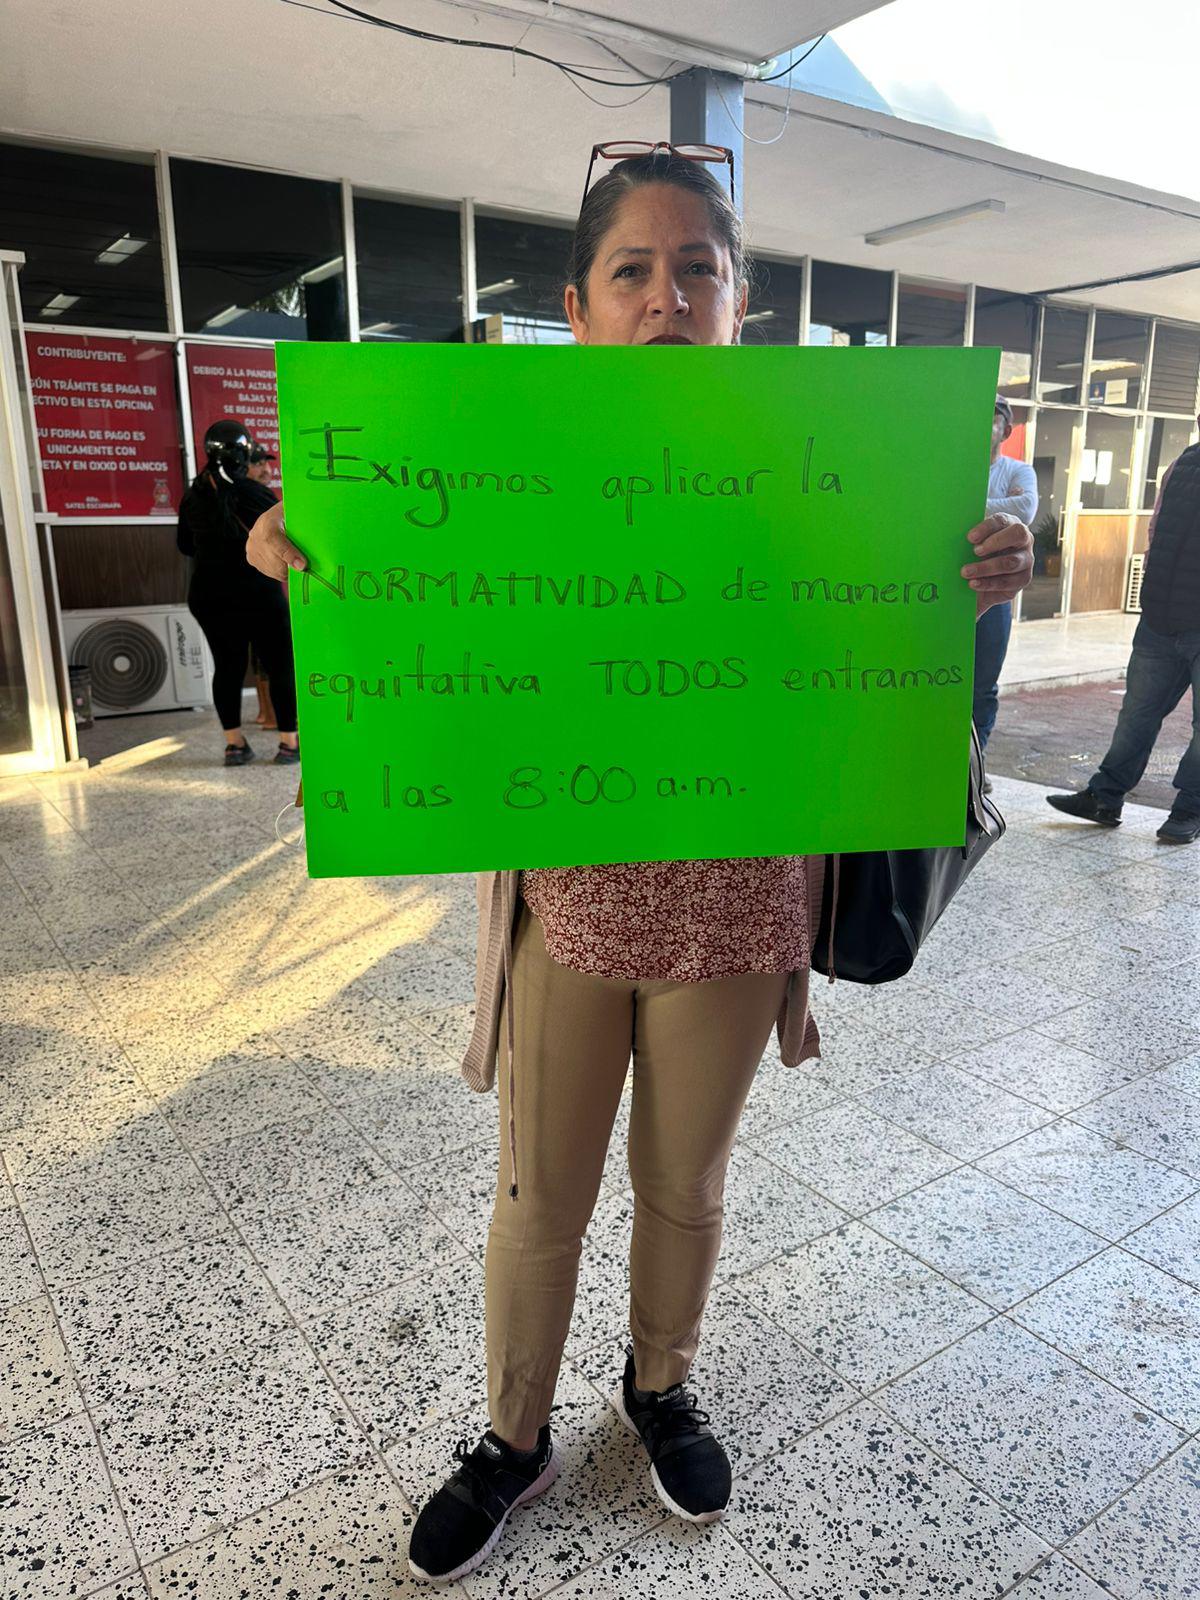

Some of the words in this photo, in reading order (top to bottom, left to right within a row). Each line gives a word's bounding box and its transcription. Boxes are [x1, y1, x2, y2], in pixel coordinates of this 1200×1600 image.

[37, 346, 127, 362] CONTRIBUYENTE:
[193, 366, 225, 376] DEBIDO
[226, 368, 233, 377] A
[234, 368, 246, 377] LA
[52, 379, 99, 392] TRÁMITE
[100, 383, 114, 393] SE
[115, 384, 141, 395] PAGA
[143, 386, 157, 396] EN
[222, 380, 246, 389] PARA
[70, 397, 85, 408] EN
[87, 398, 113, 409] ESTA
[114, 400, 154, 411] OFICINA
[238, 394, 265, 403] BAJAS
[224, 405, 235, 414] SE
[236, 406, 276, 415] REALIZAN
[244, 418, 256, 426] DE
[50, 428, 87, 439] FORMA
[88, 430, 103, 440] DE
[104, 430, 130, 441] PAGO
[132, 431, 145, 441] ES
[47, 444, 114, 456] UNICAMENTE
[115, 446, 136, 456] CON
[63, 461, 72, 470] Y
[73, 461, 87, 471] EN
[89, 462, 117, 471] OXXO
[118, 462, 127, 471] O
[128, 462, 168, 472] BANCOS
[299, 422, 554, 528] Exigimos
[601, 447, 774, 526] aplicar
[801, 436, 843, 494] la
[302, 565, 687, 608] NORMATIVIDAD
[720, 567, 770, 601] de
[790, 576, 939, 605] manera
[308, 643, 541, 722] equitativa
[588, 656, 749, 697] TODOS
[780, 649, 964, 692] entramos
[320, 789, 349, 813] a
[382, 764, 453, 809] las
[502, 763, 638, 809] 8:00
[655, 775, 748, 799] a.m.
